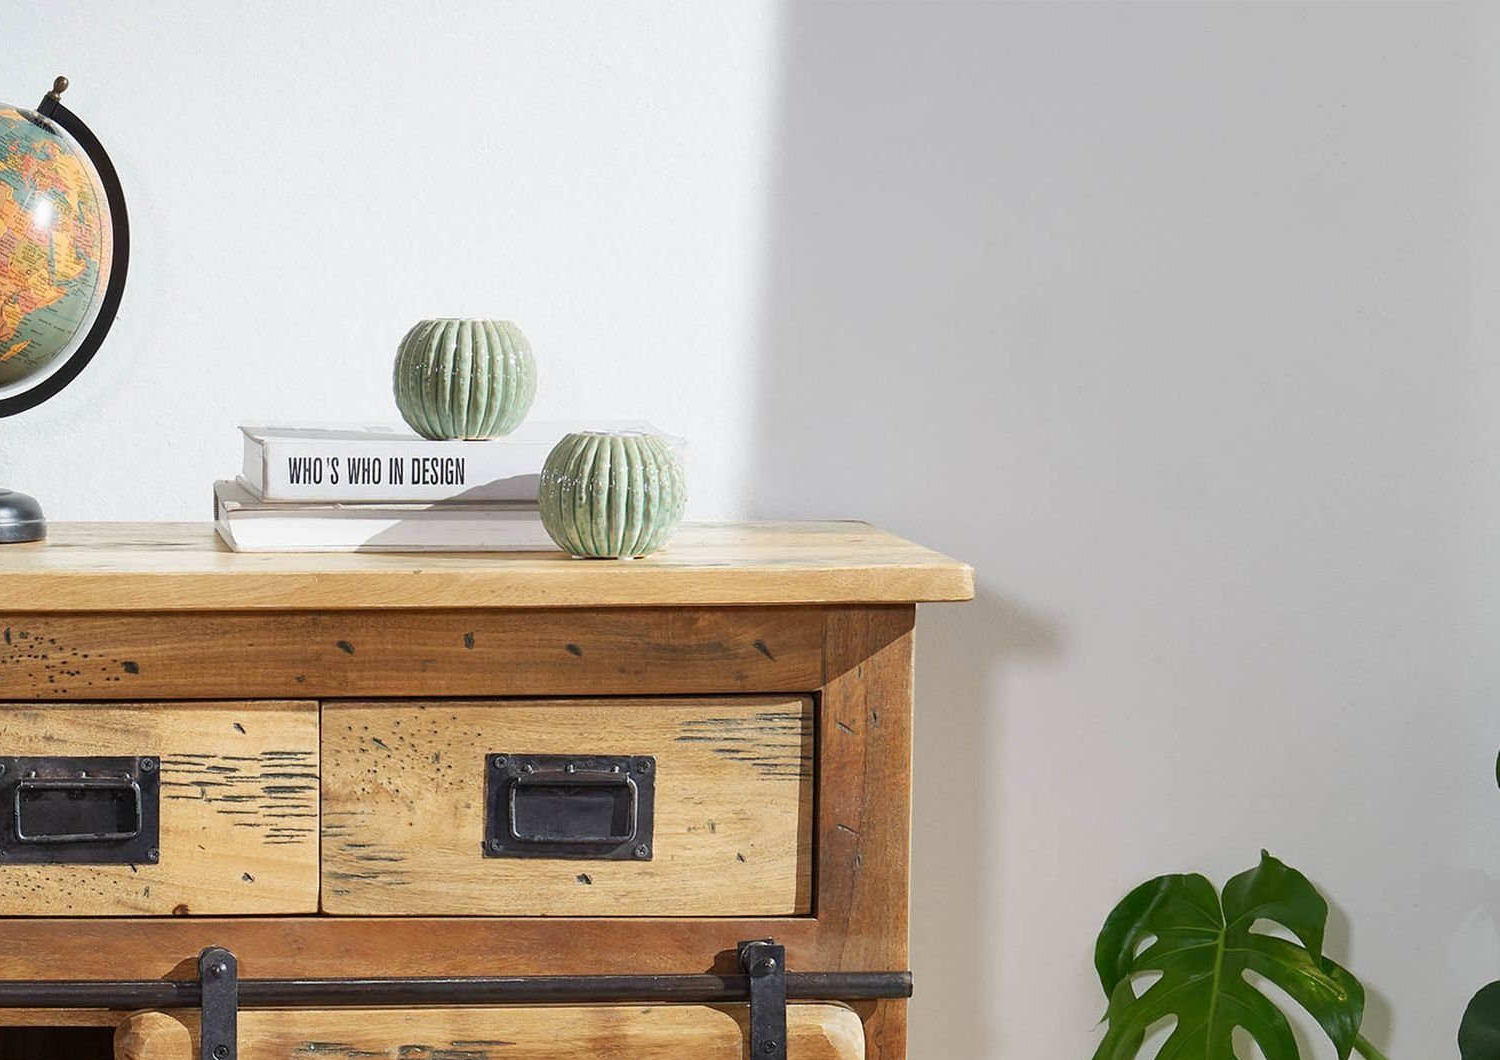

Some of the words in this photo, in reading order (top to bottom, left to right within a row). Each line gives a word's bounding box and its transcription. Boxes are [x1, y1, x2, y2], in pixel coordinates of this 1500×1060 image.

[288, 457, 340, 485] WHO'S
[347, 457, 382, 485] WHO
[389, 457, 404, 485] IN
[411, 457, 465, 485] DESIGN
